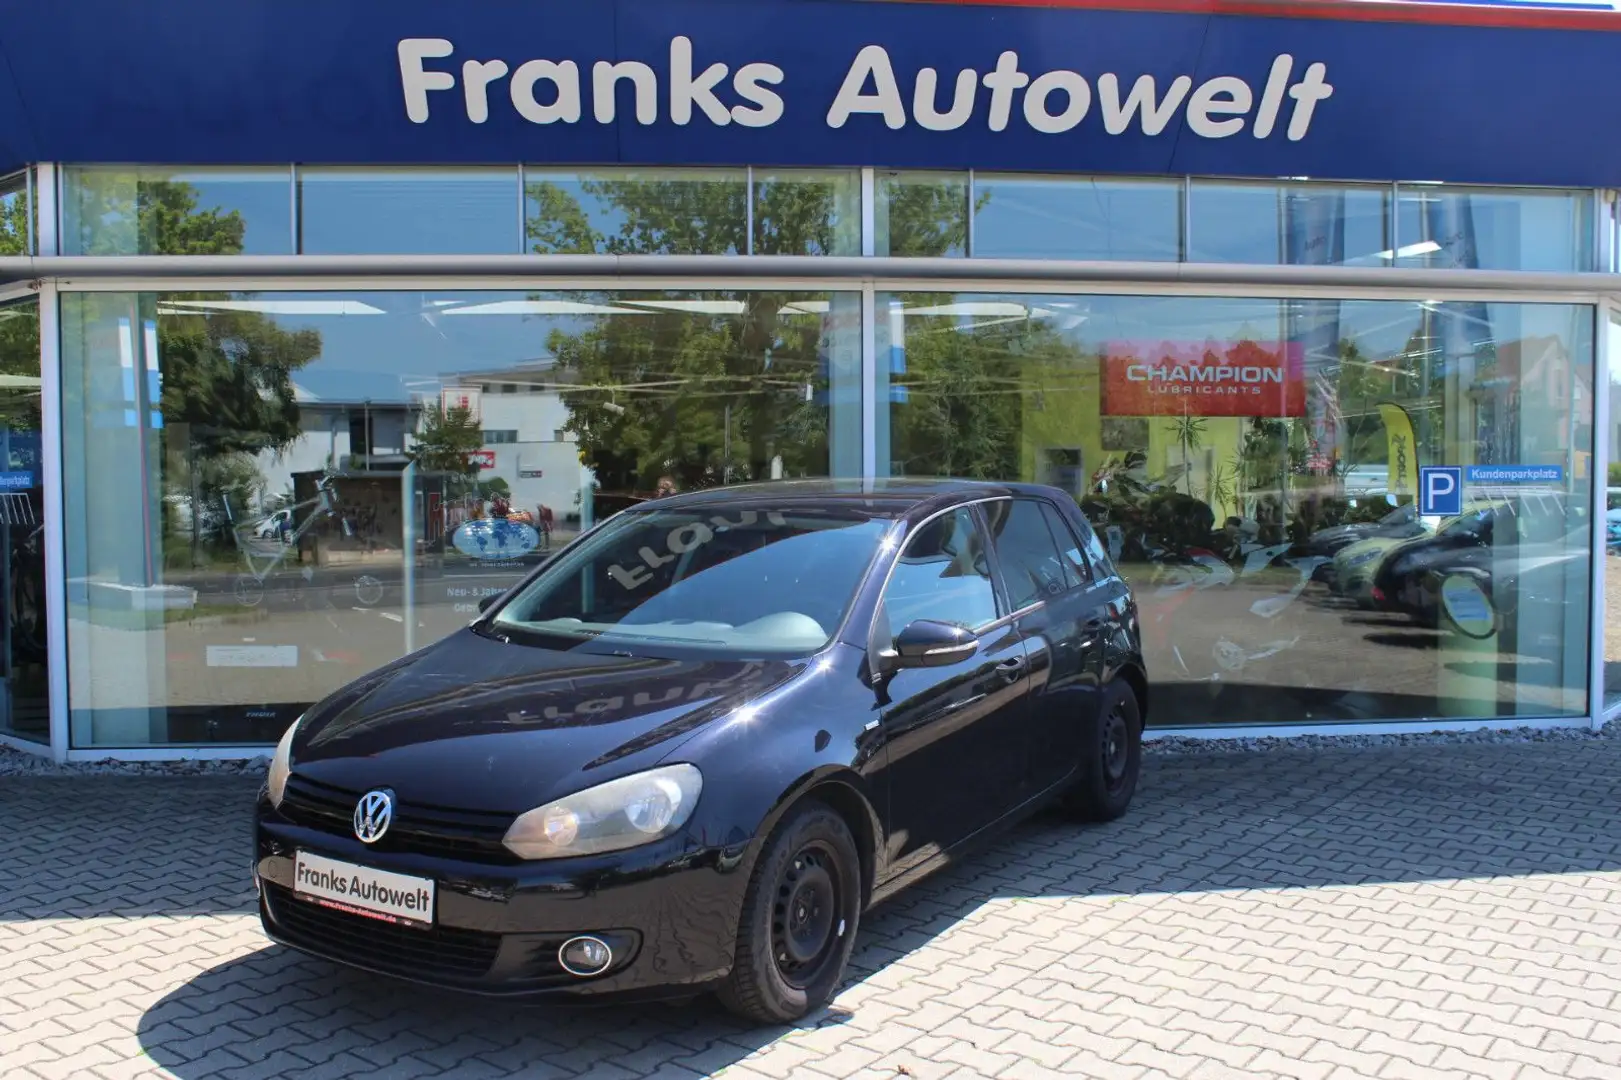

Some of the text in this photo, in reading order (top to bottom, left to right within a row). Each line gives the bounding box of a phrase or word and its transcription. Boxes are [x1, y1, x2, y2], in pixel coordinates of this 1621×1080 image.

[397, 36, 1334, 143] Franks Autowelt
[1126, 364, 1284, 382] CHAMPION
[1147, 386, 1261, 395] LUBRICANTS
[1428, 469, 1558, 510] P Kundenparkplatz
[297, 862, 430, 912] Franks Autowelt
